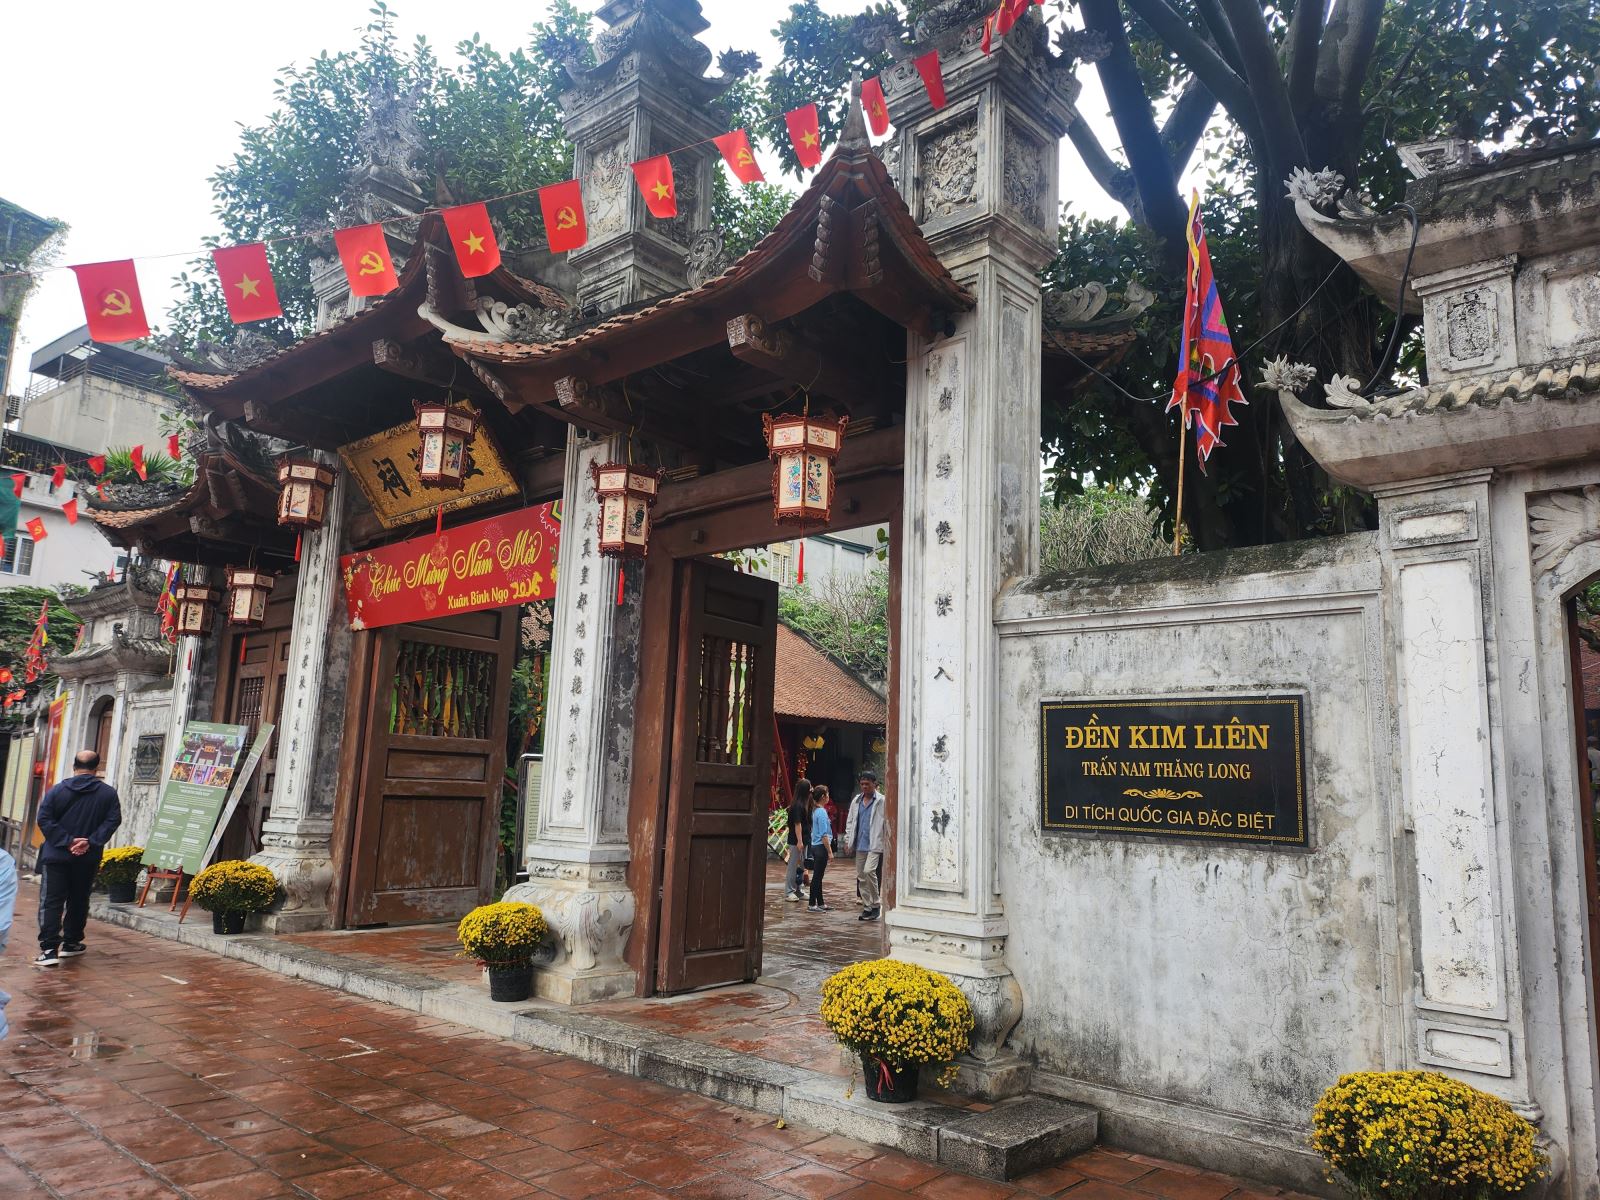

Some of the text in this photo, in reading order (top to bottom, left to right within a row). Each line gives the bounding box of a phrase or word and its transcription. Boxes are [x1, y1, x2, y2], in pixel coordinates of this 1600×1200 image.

[368, 564, 401, 602] Chúc
[452, 539, 493, 580] Năm
[496, 529, 543, 570] Mới
[448, 571, 543, 610] Xuân Bính Ngọ 2026
[1065, 713, 1270, 750] ĐỀN KIM LIÊN
[1082, 755, 1251, 780] TRẤN NAM THĂNG LONG
[1065, 804, 1275, 833] DI TÍCH QUỐC GIA ĐẶC BIỆT
